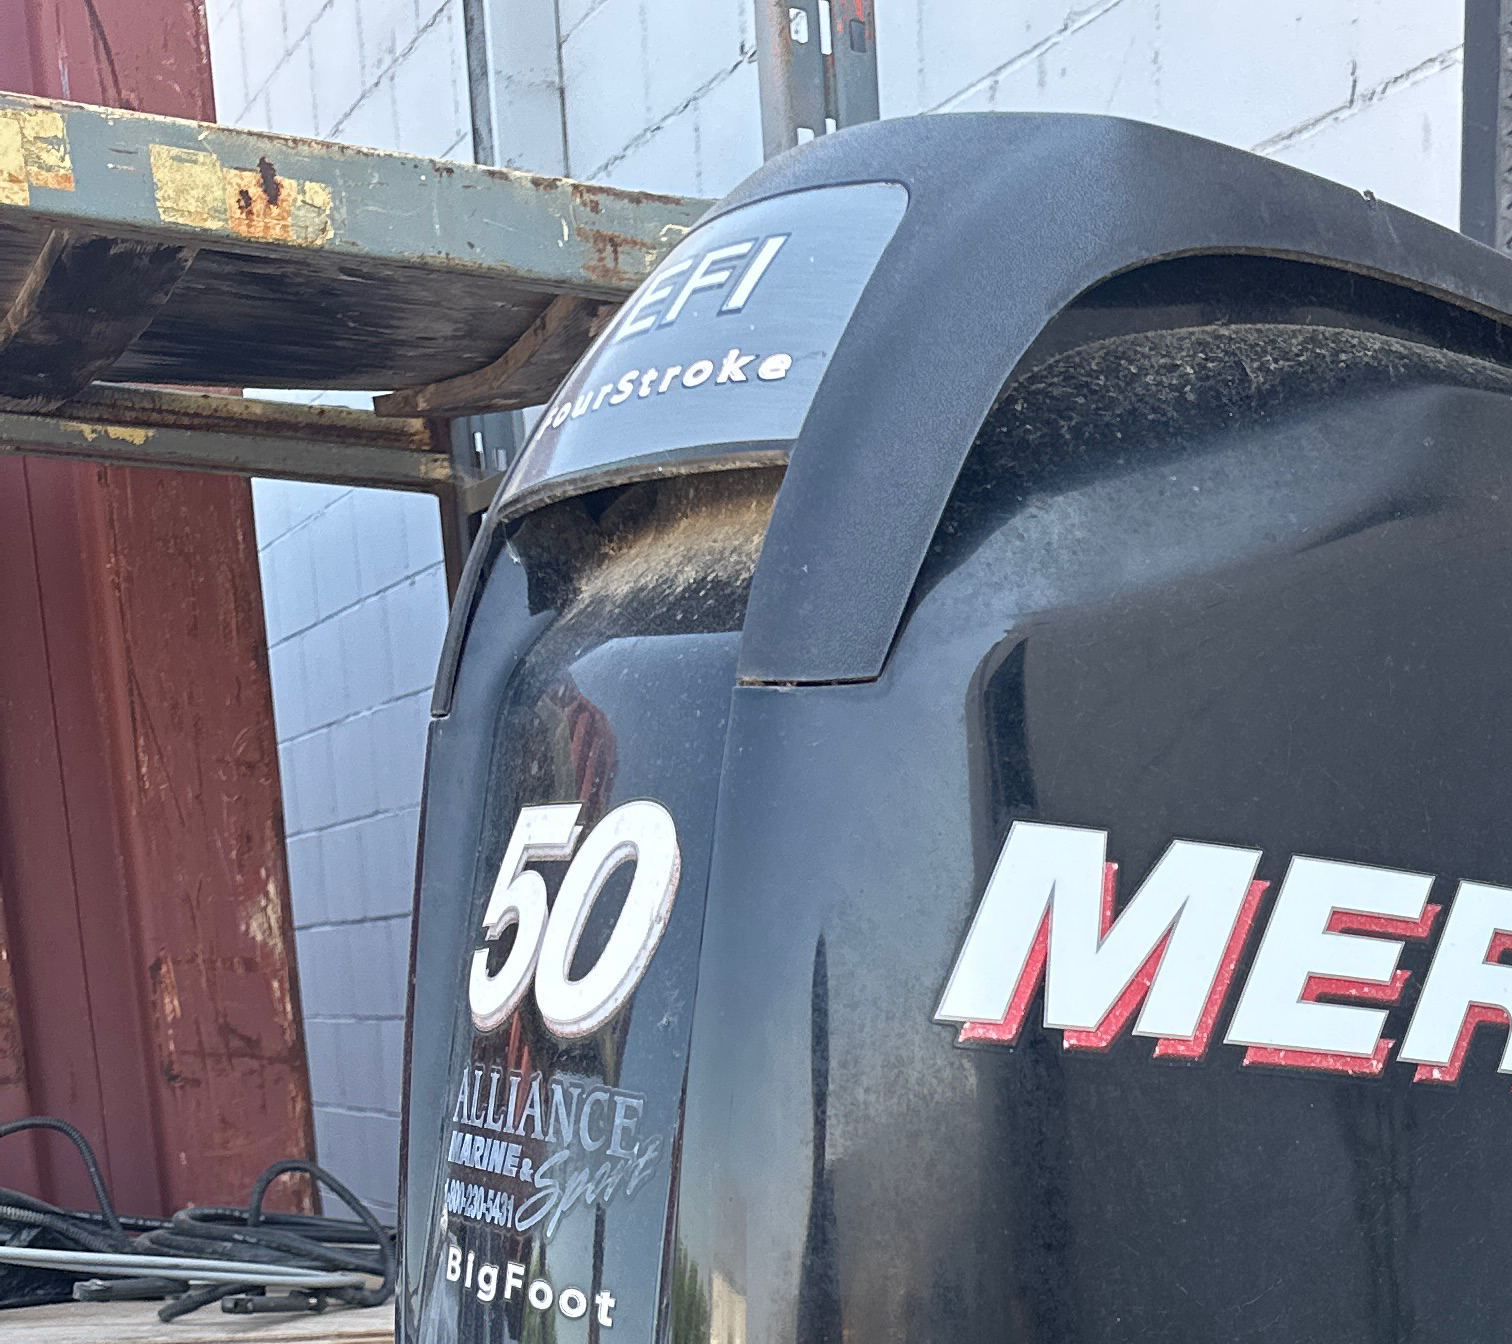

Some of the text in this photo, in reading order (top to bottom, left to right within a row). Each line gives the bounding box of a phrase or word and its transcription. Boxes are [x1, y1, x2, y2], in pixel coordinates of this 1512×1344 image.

[612, 232, 792, 345] EFI
[468, 800, 682, 1037] 50
[448, 1130, 522, 1178] MARINE
[453, 1066, 644, 1161] ALLIANCE
[446, 1246, 617, 1328] BigFoot
